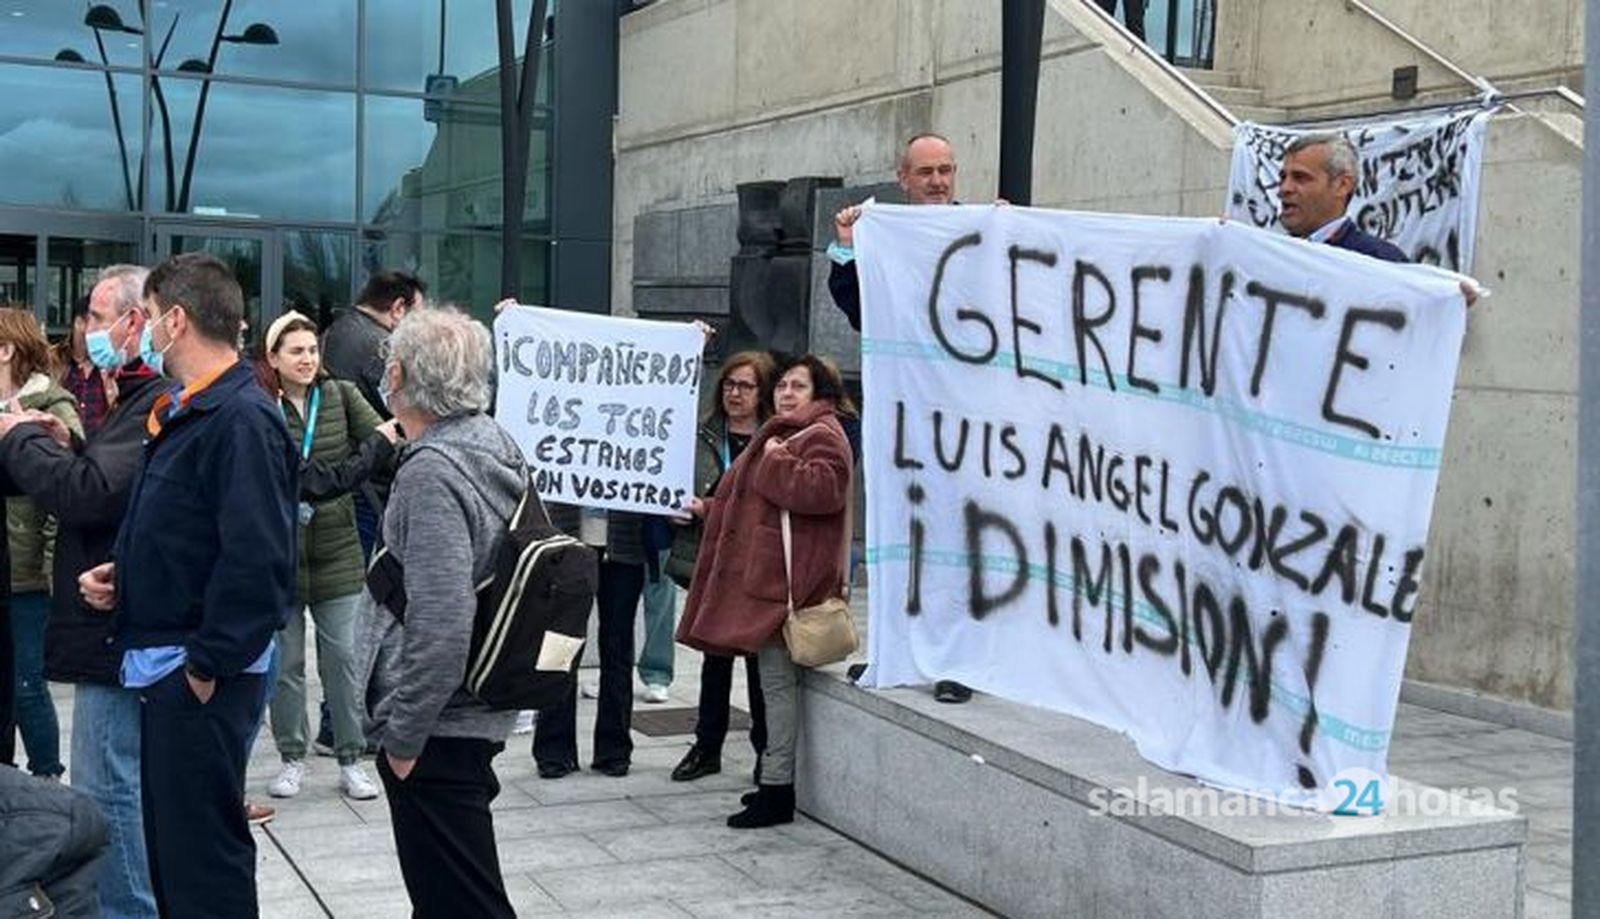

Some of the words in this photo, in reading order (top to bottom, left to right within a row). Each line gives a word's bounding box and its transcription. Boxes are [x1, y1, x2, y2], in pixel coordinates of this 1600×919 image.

[502, 331, 701, 395] ¡COMPAÑEROS!
[928, 231, 1407, 440] GERENTE
[526, 390, 583, 431] LOS
[597, 402, 674, 441] TCAE
[535, 434, 666, 475] ESTAMOS
[893, 400, 1027, 480] LUIS
[1041, 422, 1179, 534] ANGEL
[527, 464, 563, 495] ON
[571, 472, 687, 510] VOSOTROS
